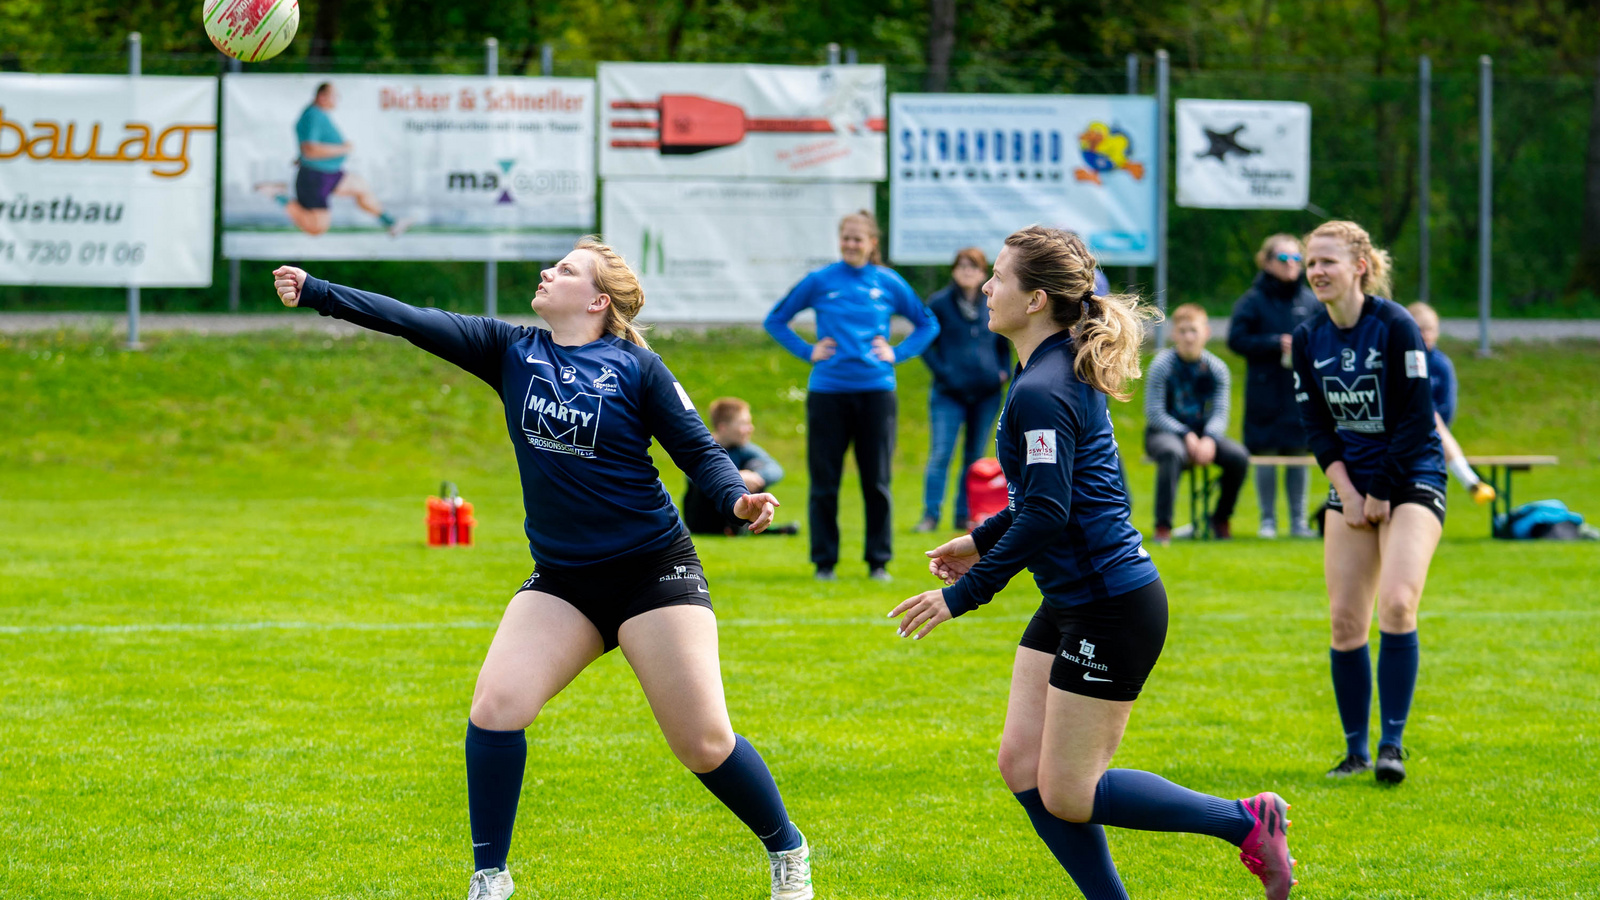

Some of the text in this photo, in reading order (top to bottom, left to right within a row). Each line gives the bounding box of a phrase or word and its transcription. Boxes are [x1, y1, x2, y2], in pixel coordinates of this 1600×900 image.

[379, 86, 584, 113] Dicker & Schneller
[26, 239, 73, 266] 730
[78, 240, 108, 266] 01
[1341, 348, 1356, 372] 2
[1328, 390, 1375, 404] MARTY
[528, 395, 594, 427] MARTY
[1061, 650, 1108, 672] Bank Linth
